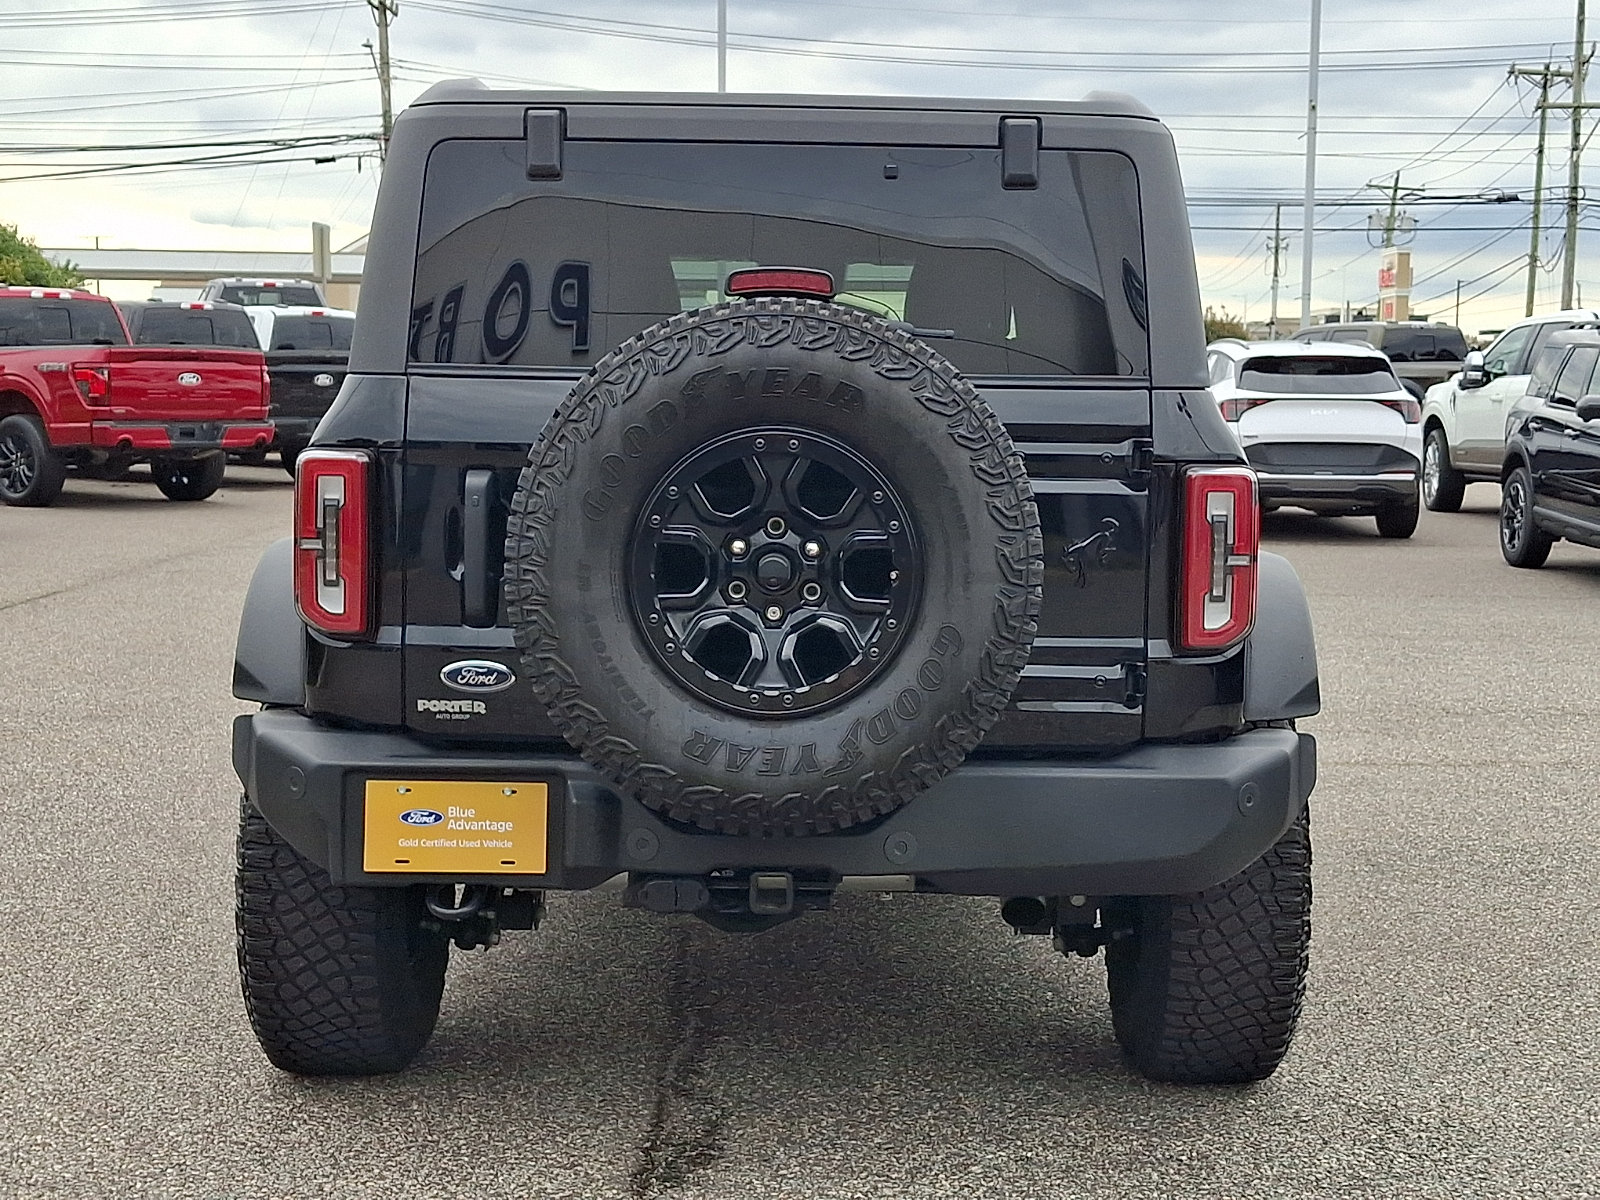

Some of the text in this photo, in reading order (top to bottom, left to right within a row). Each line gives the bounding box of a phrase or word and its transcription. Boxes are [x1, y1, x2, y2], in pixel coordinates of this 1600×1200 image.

[457, 666, 498, 685] Ford
[417, 699, 486, 714] PORTER
[407, 810, 436, 824] Ford
[447, 806, 476, 818] Blue
[447, 819, 514, 832] Advantage
[398, 838, 513, 848] Gold Certified Used Vehicle
